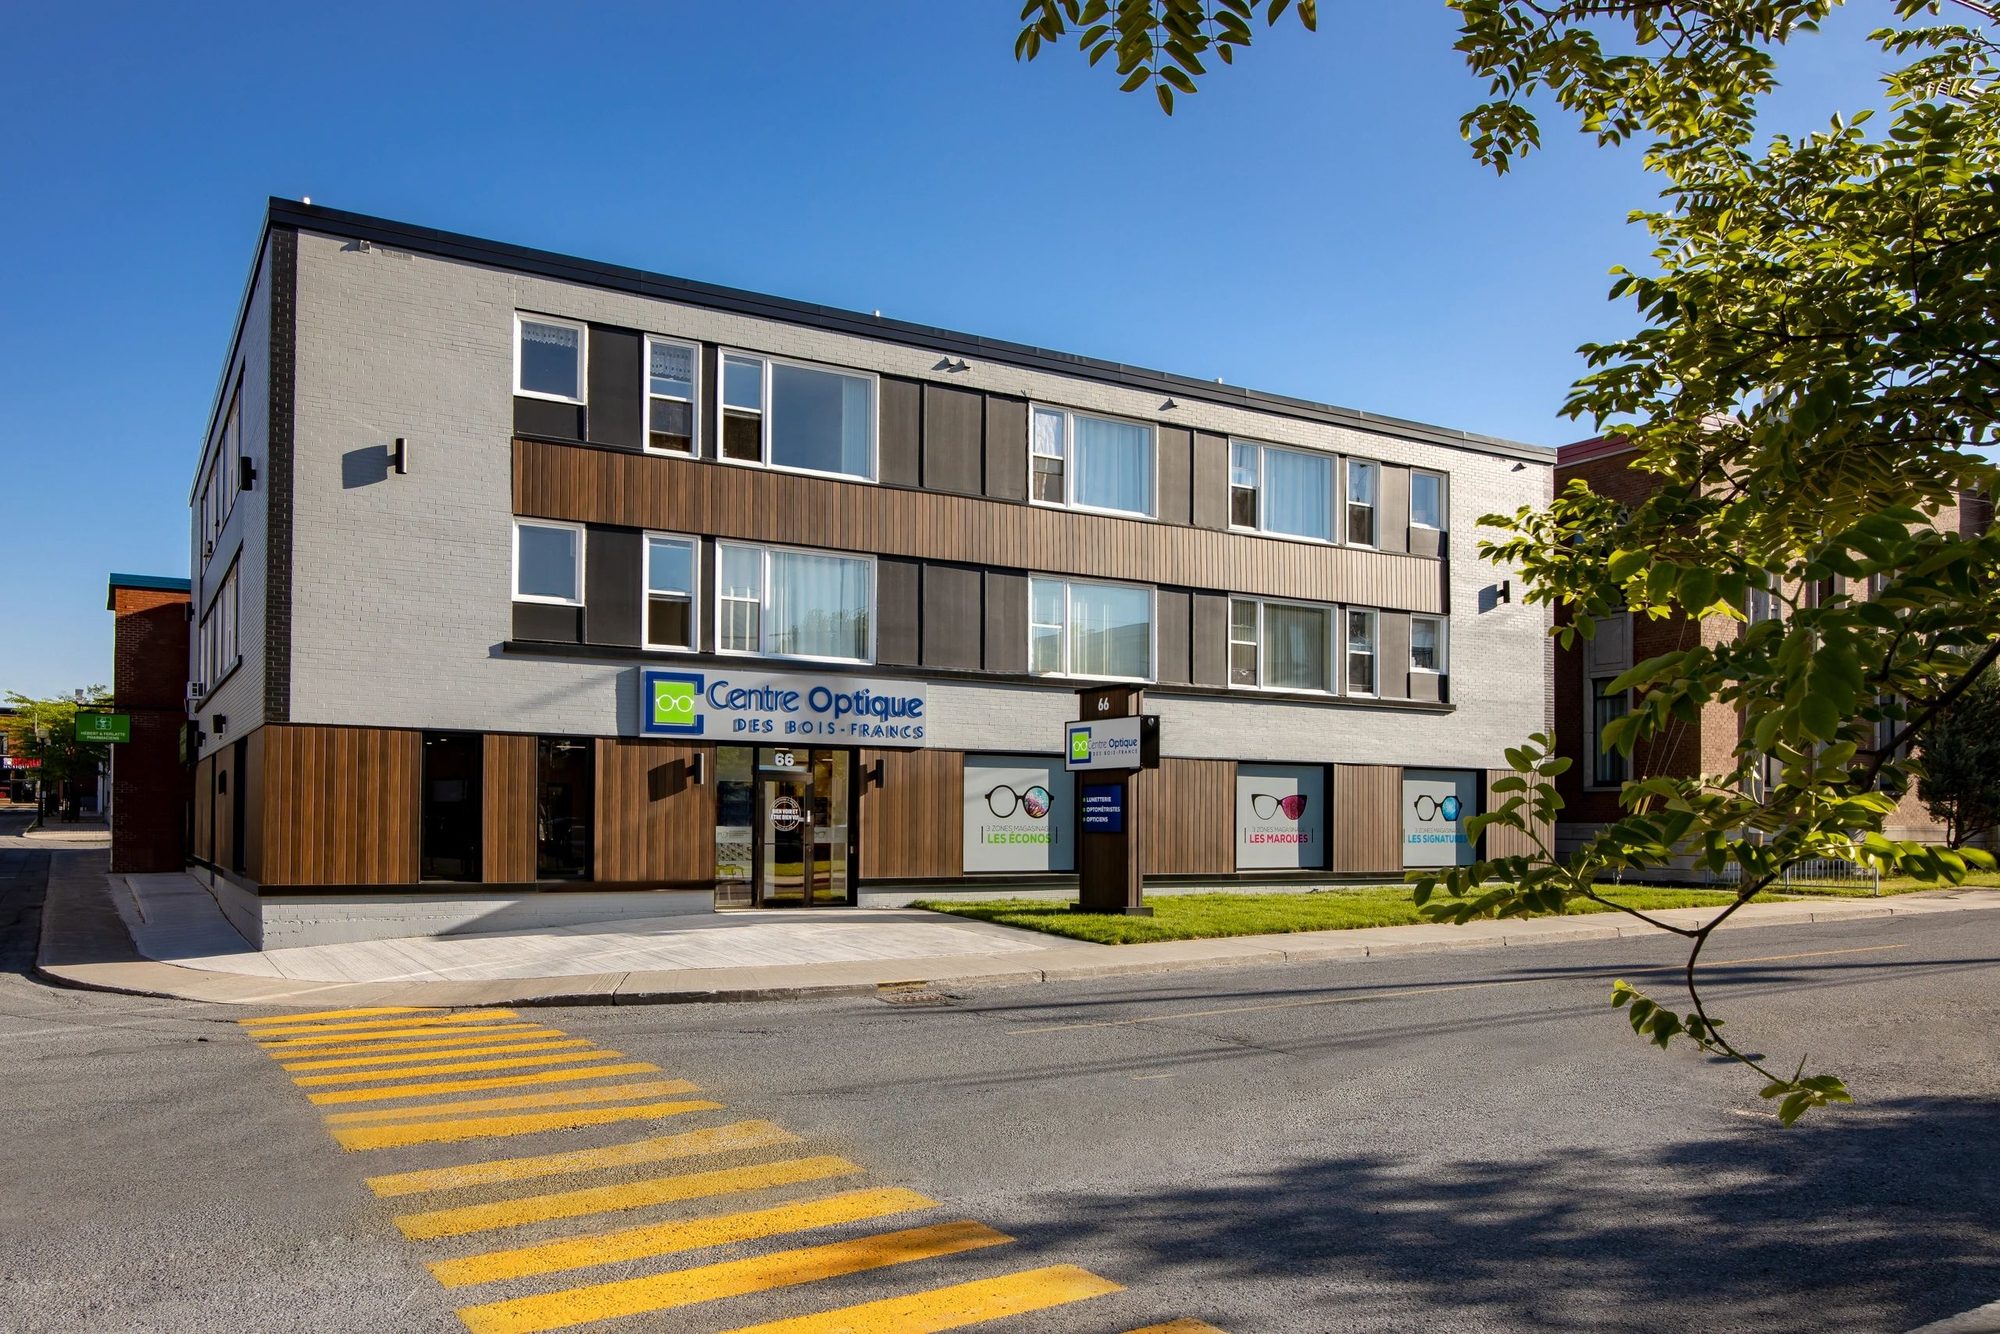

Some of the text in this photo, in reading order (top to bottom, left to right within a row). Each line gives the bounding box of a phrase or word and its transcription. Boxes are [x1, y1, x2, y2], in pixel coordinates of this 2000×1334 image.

[709, 680, 924, 721] Centre Optique
[1098, 697, 1109, 711] 66
[736, 719, 924, 738] DES BOIS-FRANCS
[1088, 738, 1138, 749] Centre Optique
[774, 752, 795, 767] 66
[988, 831, 1053, 844] LES ÉCONOS
[1249, 834, 1309, 844] LES MARQUES
[1407, 834, 1422, 844] LES
